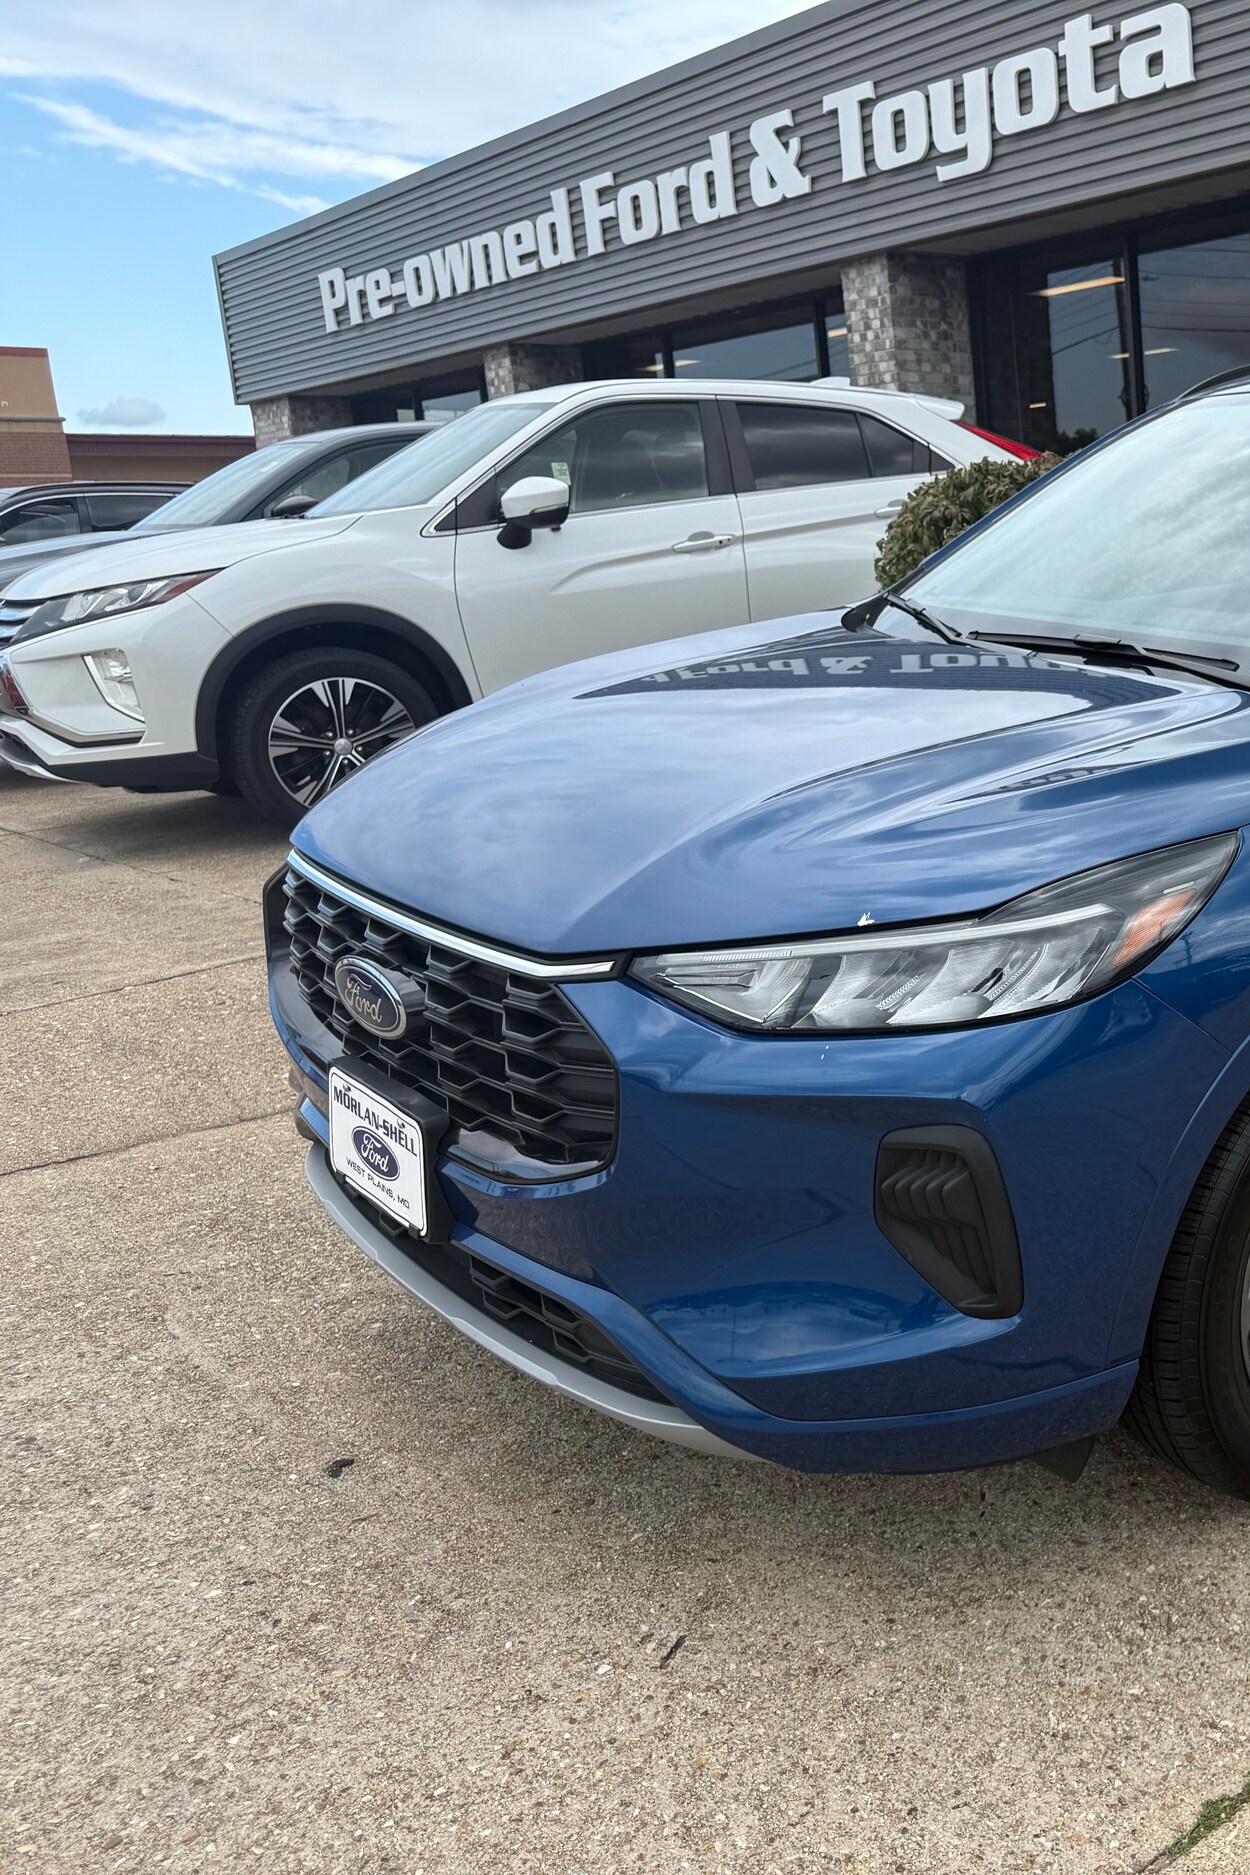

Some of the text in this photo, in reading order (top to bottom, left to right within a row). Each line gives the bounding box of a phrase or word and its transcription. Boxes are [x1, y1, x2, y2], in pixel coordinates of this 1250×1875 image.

[317, 2, 1196, 333] Pre-owned Ford & Toyota
[346, 974, 382, 1022] Ford
[333, 1085, 418, 1157] MORLAN-SHELL
[361, 1133, 389, 1172] Ford
[345, 1156, 410, 1209] WEST PLAINS, MO
